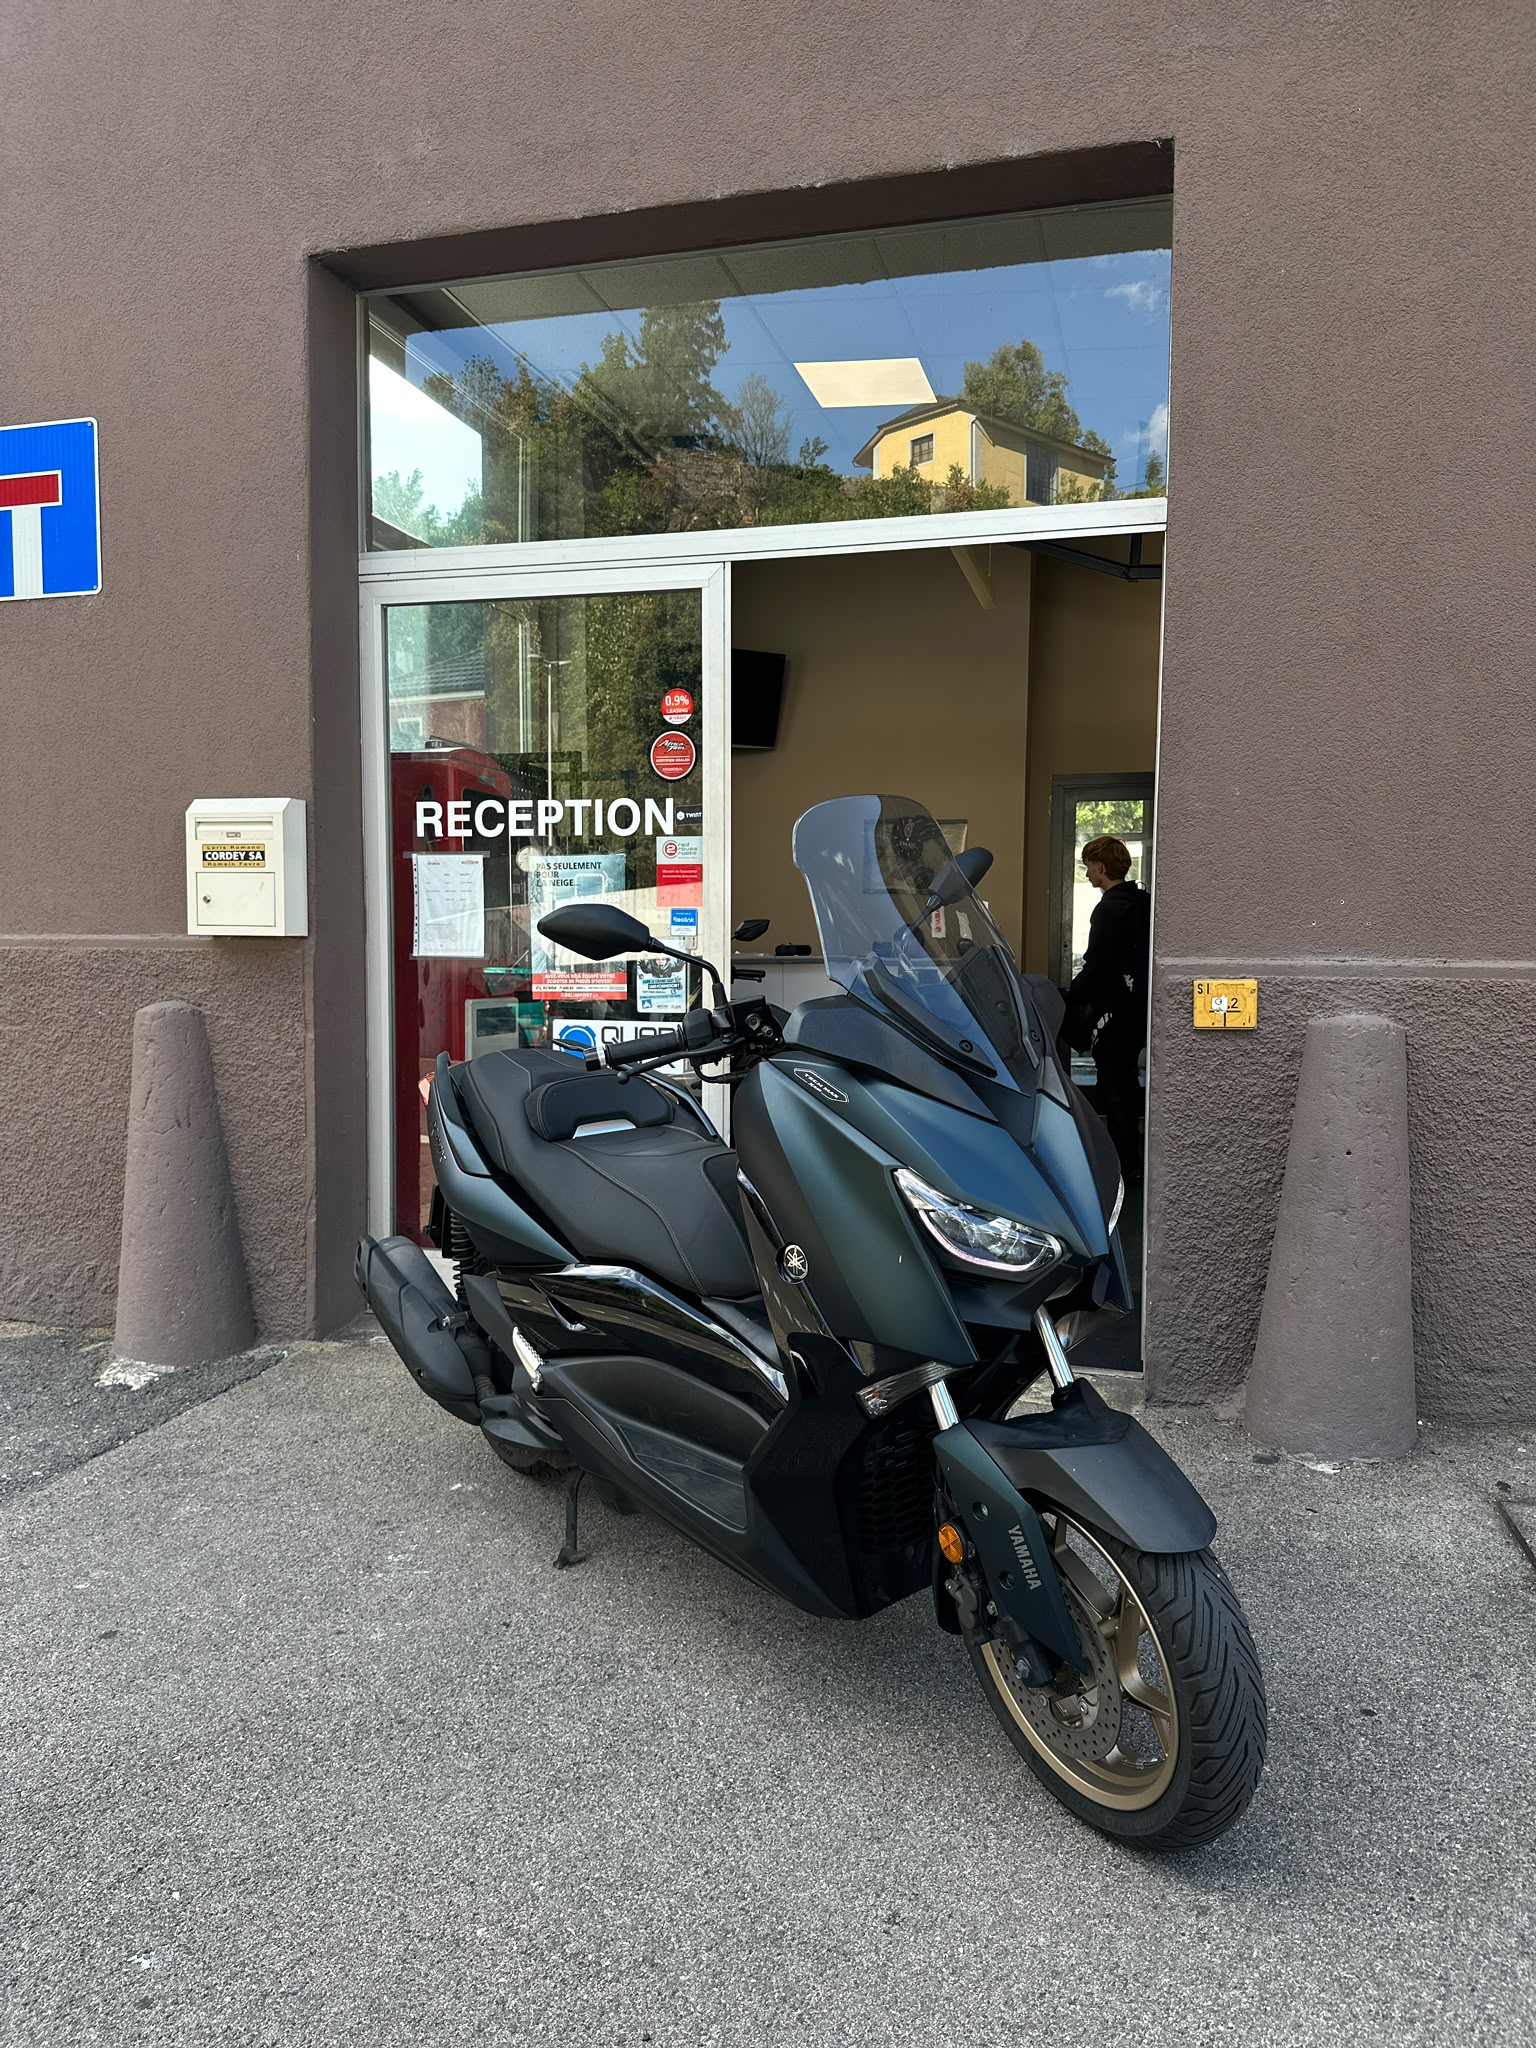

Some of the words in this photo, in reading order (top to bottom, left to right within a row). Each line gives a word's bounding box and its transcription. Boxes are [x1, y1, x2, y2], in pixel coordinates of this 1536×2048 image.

[665, 695, 690, 706] 0.9%
[416, 797, 673, 837] RECEPTION
[205, 852, 246, 860] CORDEY
[248, 852, 263, 860] SA
[553, 862, 602, 870] SEULEMENT
[536, 879, 547, 887] LA
[1007, 1524, 1043, 1590] YAMAHA
